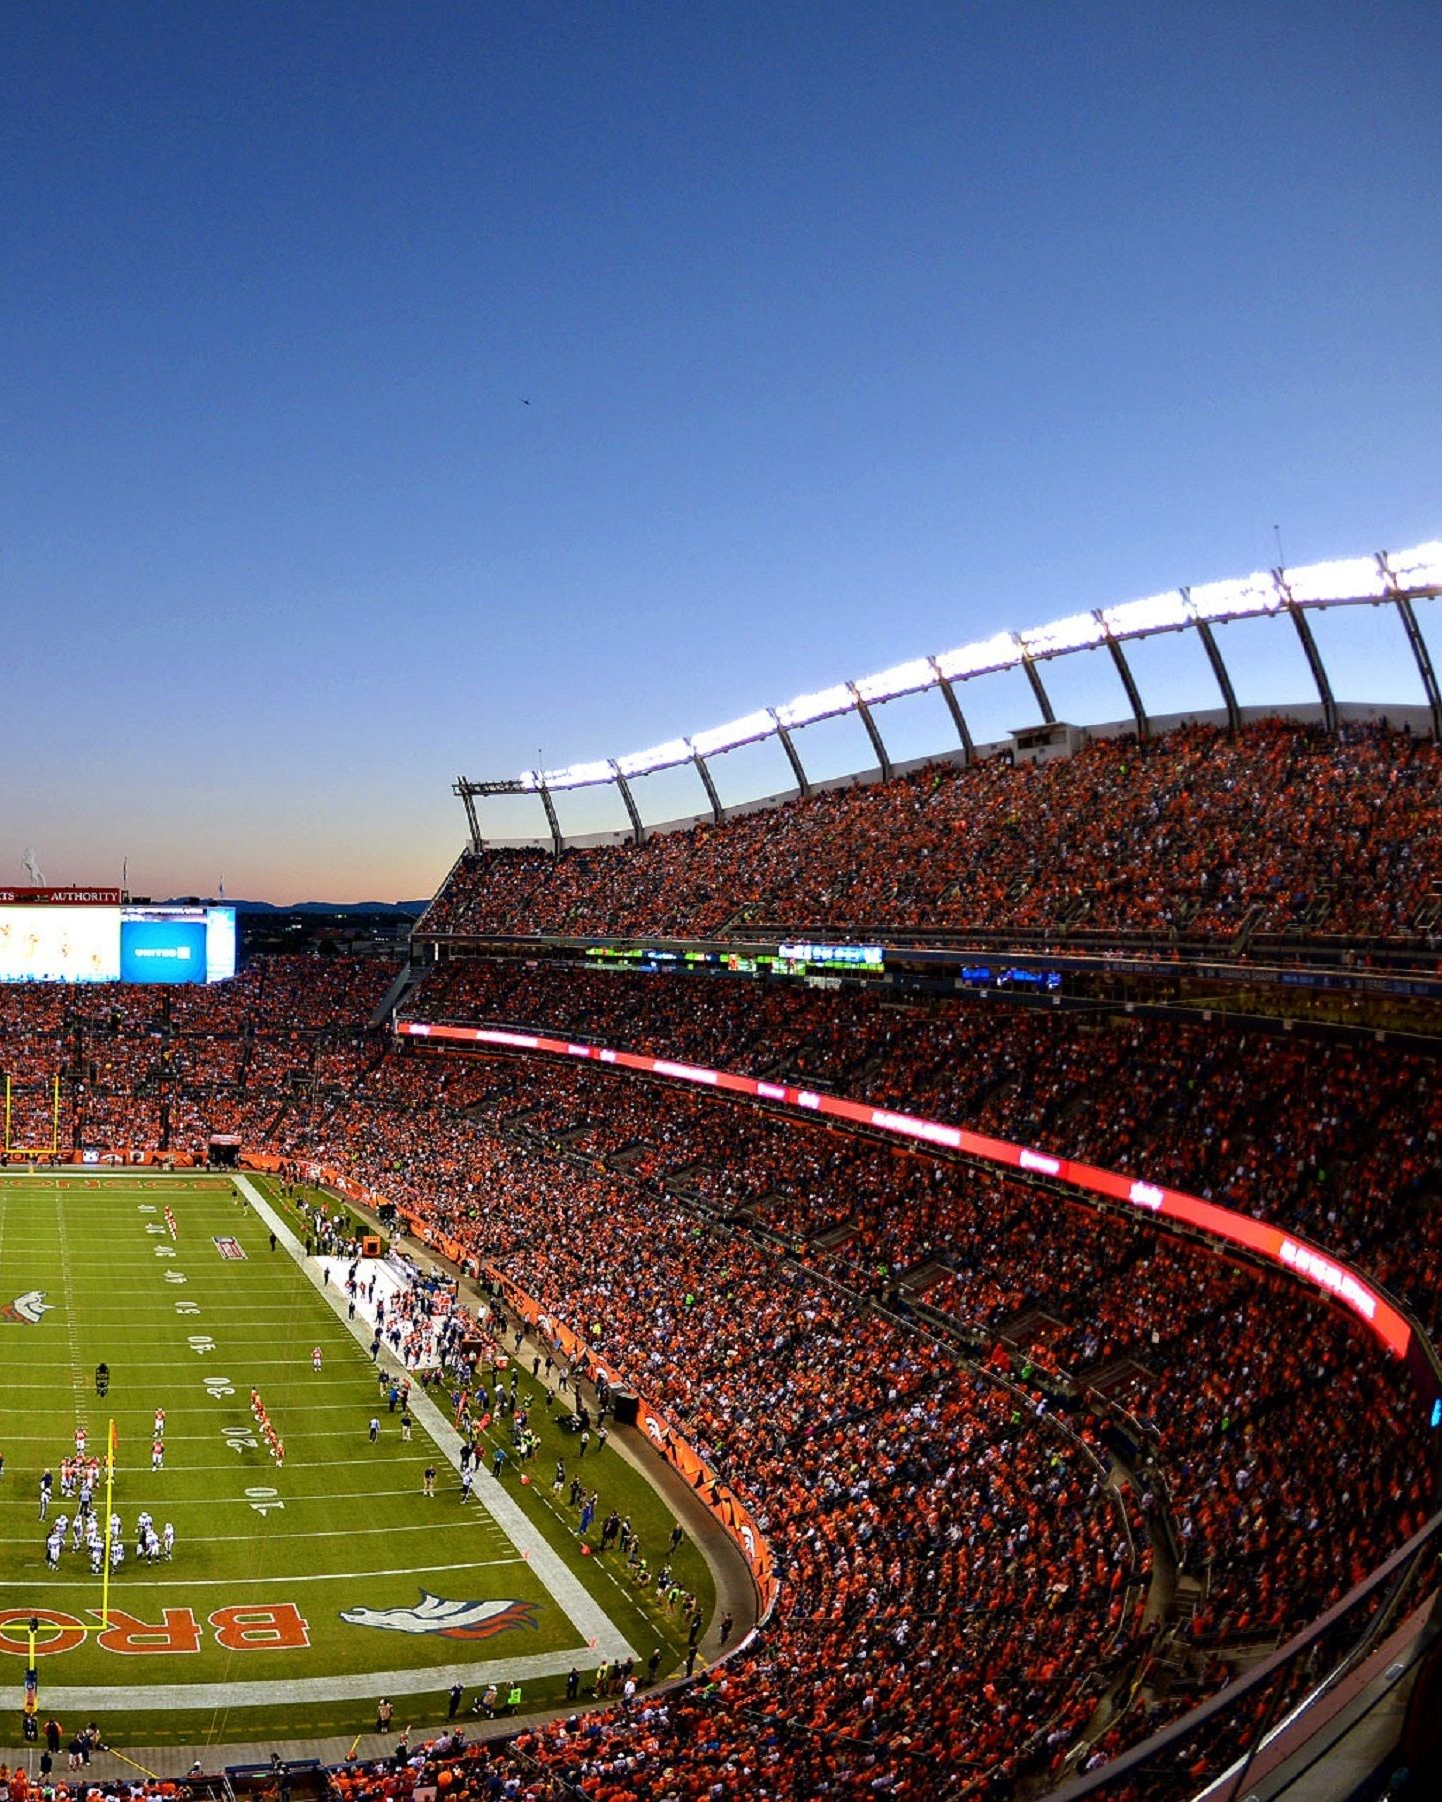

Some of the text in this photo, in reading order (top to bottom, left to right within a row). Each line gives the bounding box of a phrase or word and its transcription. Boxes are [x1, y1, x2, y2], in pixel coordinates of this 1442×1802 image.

[51, 891, 118, 902] AUTHORITY
[175, 1301, 201, 1315] 50
[187, 1336, 216, 1352] 40
[203, 1377, 236, 1397] 30
[220, 1427, 260, 1451] 20
[244, 1487, 286, 1511] 10
